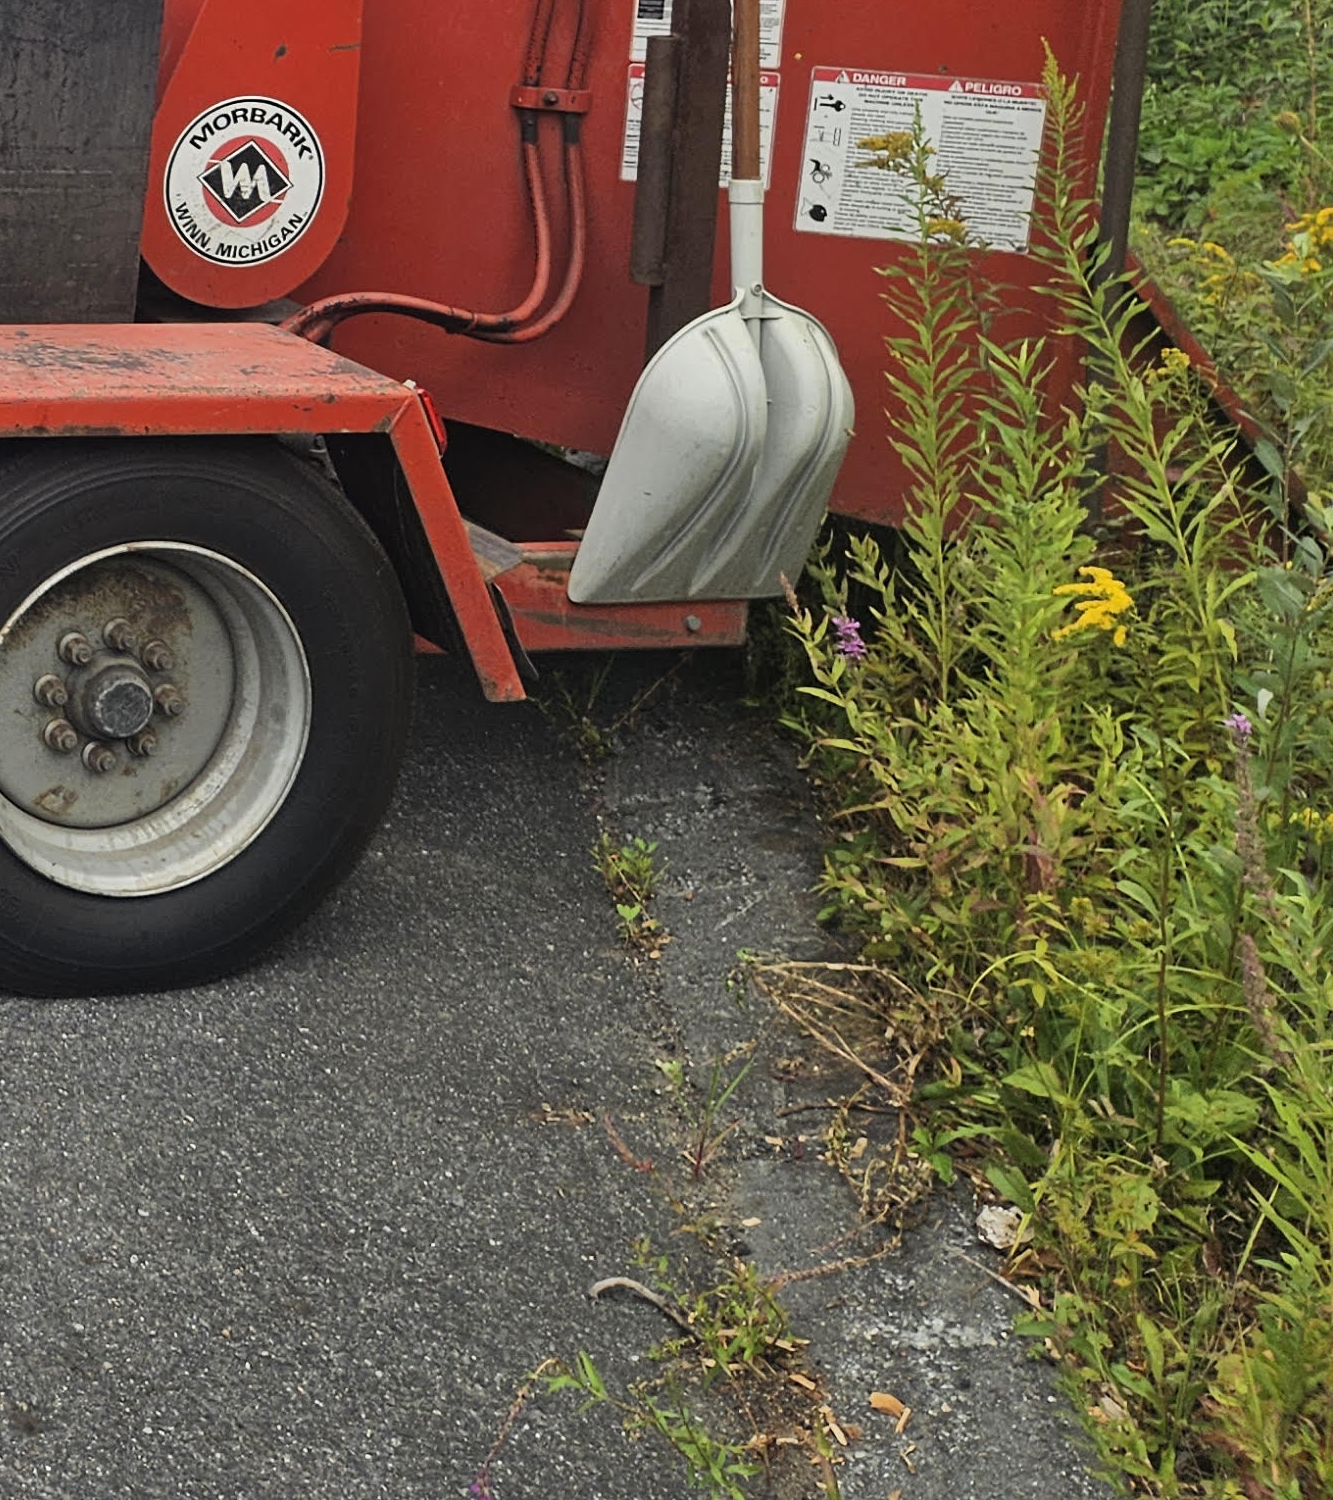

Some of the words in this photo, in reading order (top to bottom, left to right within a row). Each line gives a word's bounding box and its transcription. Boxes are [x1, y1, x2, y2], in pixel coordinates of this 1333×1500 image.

[852, 72, 907, 87] DANGER
[964, 81, 1023, 96] PELIGRO
[189, 107, 313, 160] MORBARK
[175, 201, 213, 252] WINN,
[215, 213, 304, 259] MICHIGAN
